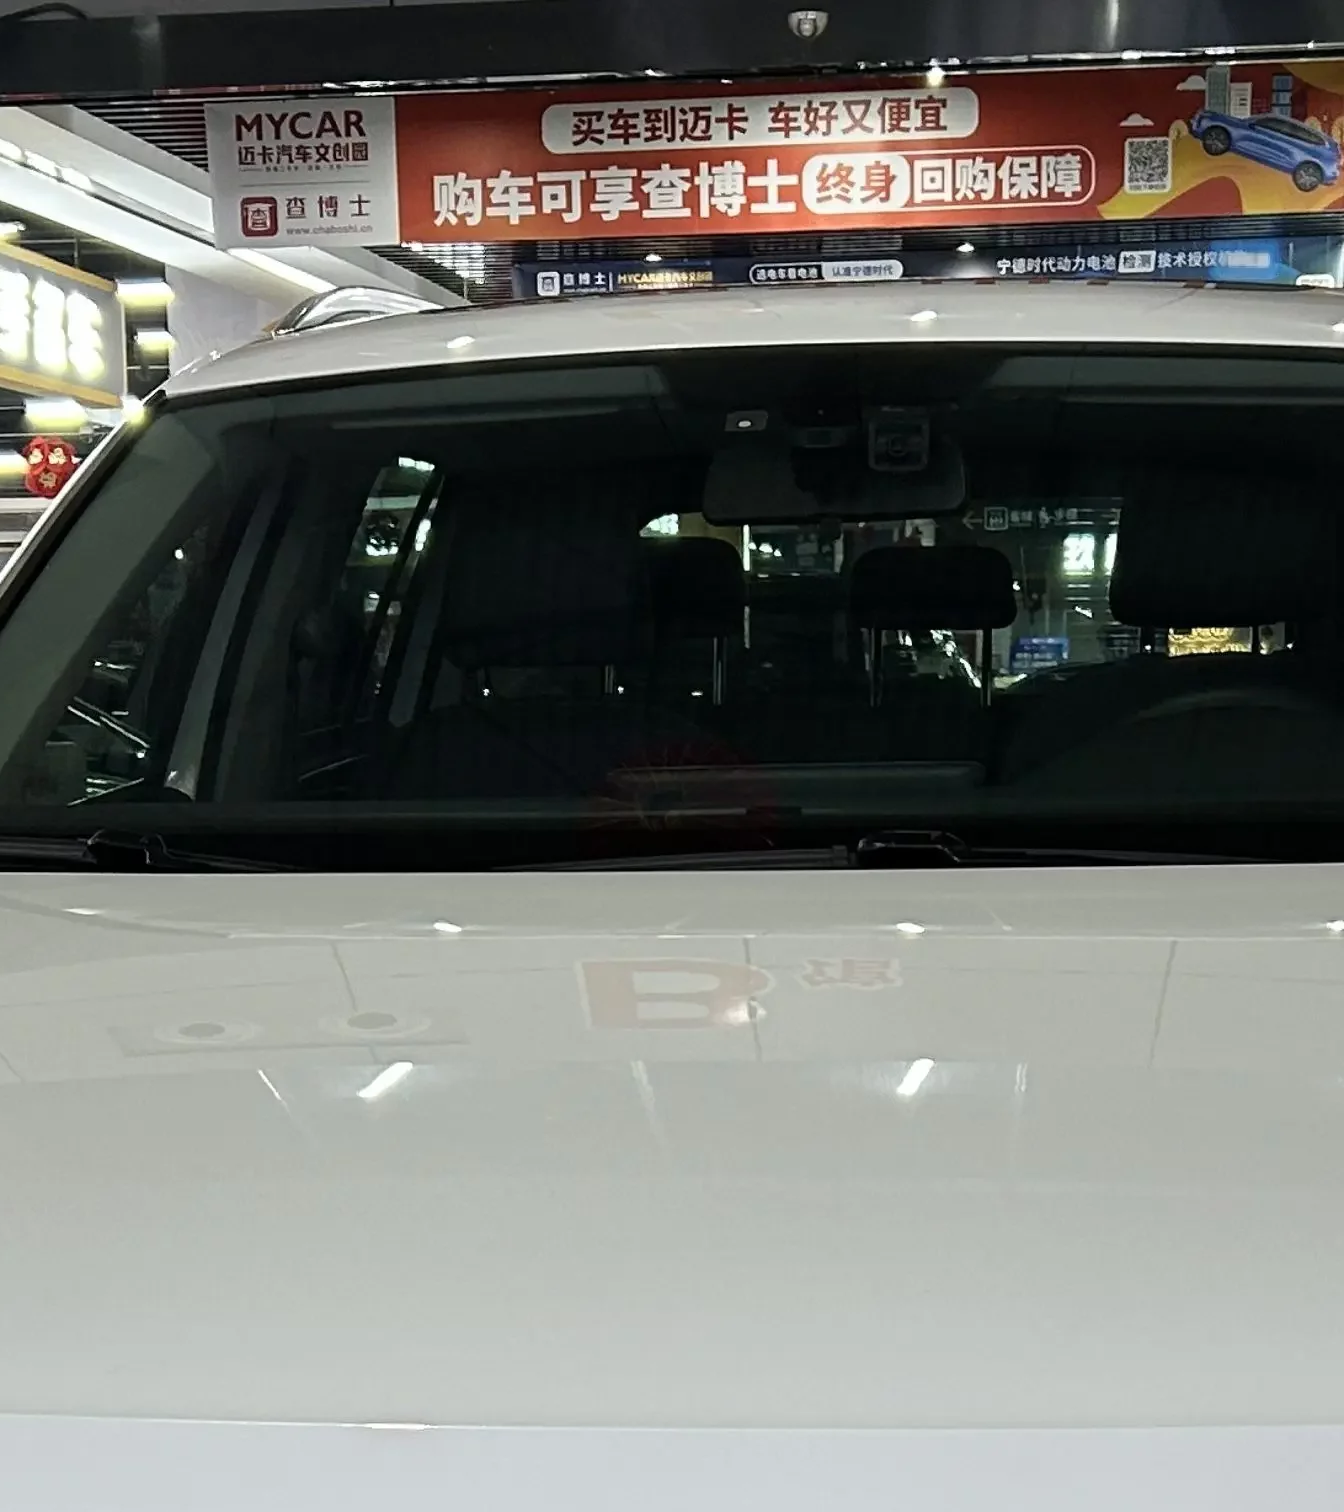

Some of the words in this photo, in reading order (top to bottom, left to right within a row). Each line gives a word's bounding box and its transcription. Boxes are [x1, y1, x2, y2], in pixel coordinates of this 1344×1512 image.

[235, 109, 367, 142] MYCAR
[571, 102, 749, 147] 买车到迈卡
[767, 95, 948, 139] 车好又便宜
[238, 142, 369, 166] 迈卡汽车文创园
[285, 195, 371, 220] 查博士
